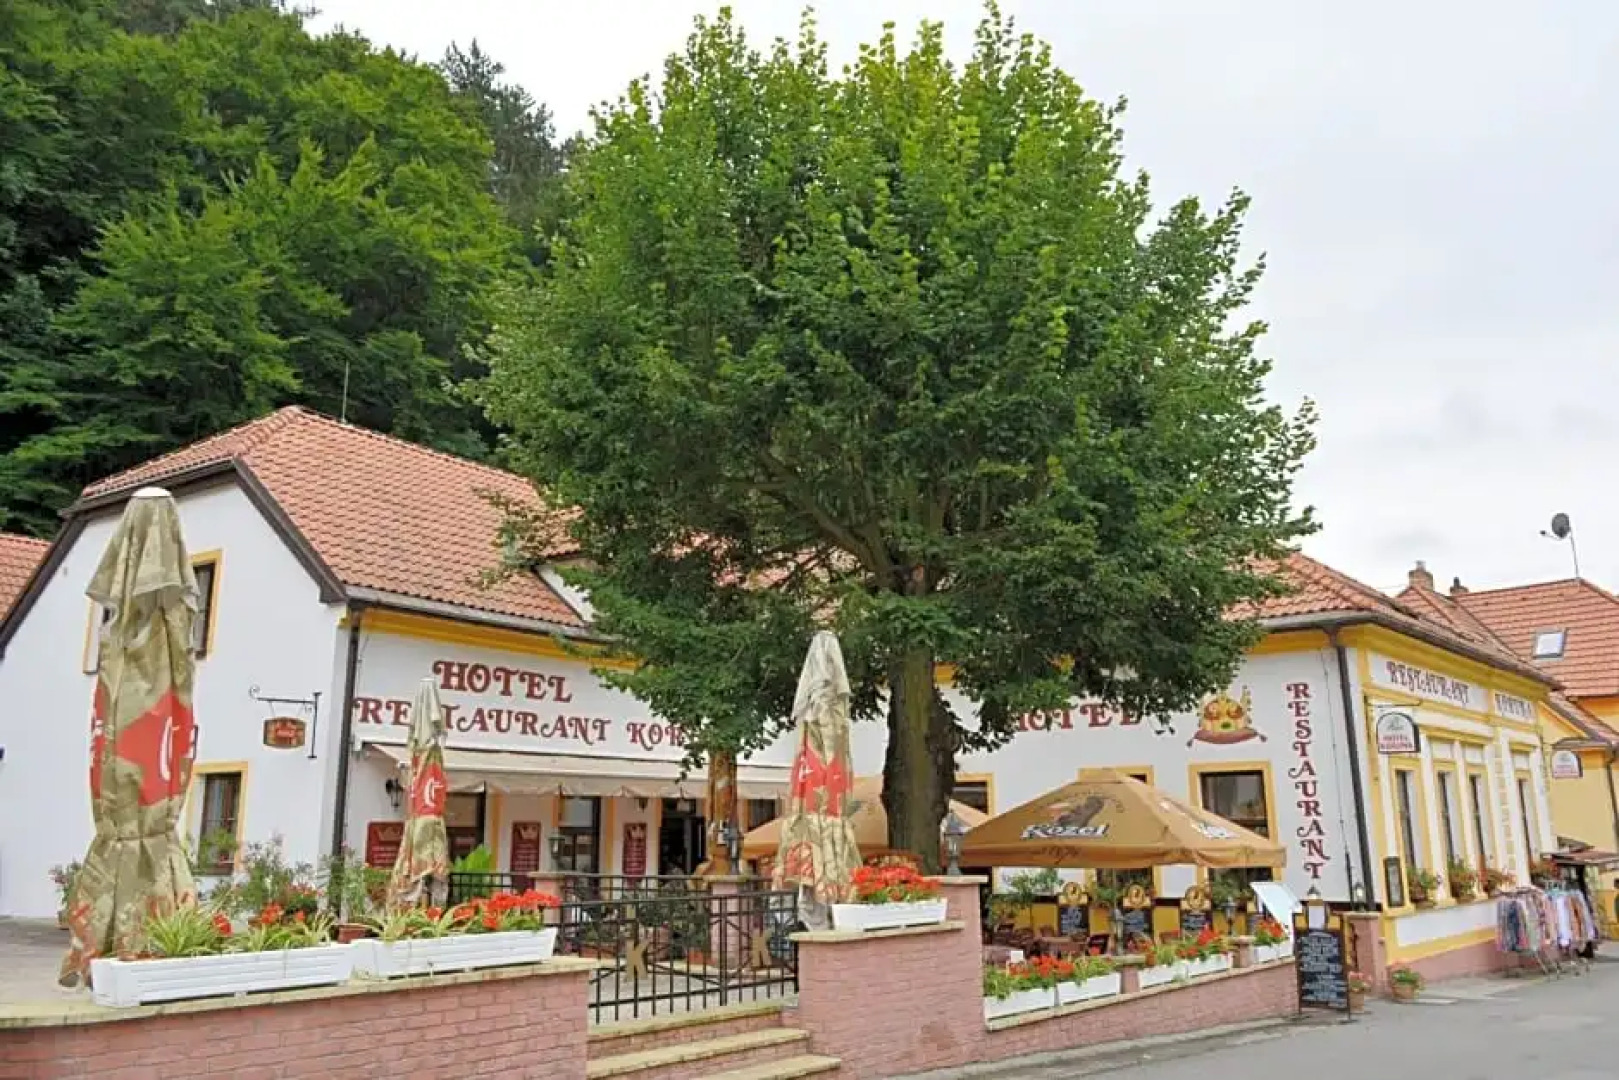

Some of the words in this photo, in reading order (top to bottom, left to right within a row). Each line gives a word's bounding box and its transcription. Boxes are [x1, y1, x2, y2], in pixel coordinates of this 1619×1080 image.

[433, 660, 572, 703] HOTEL
[354, 697, 611, 745] RETAURANT
[626, 722, 687, 751] KOR
[1286, 682, 1331, 879] RESTAURANT
